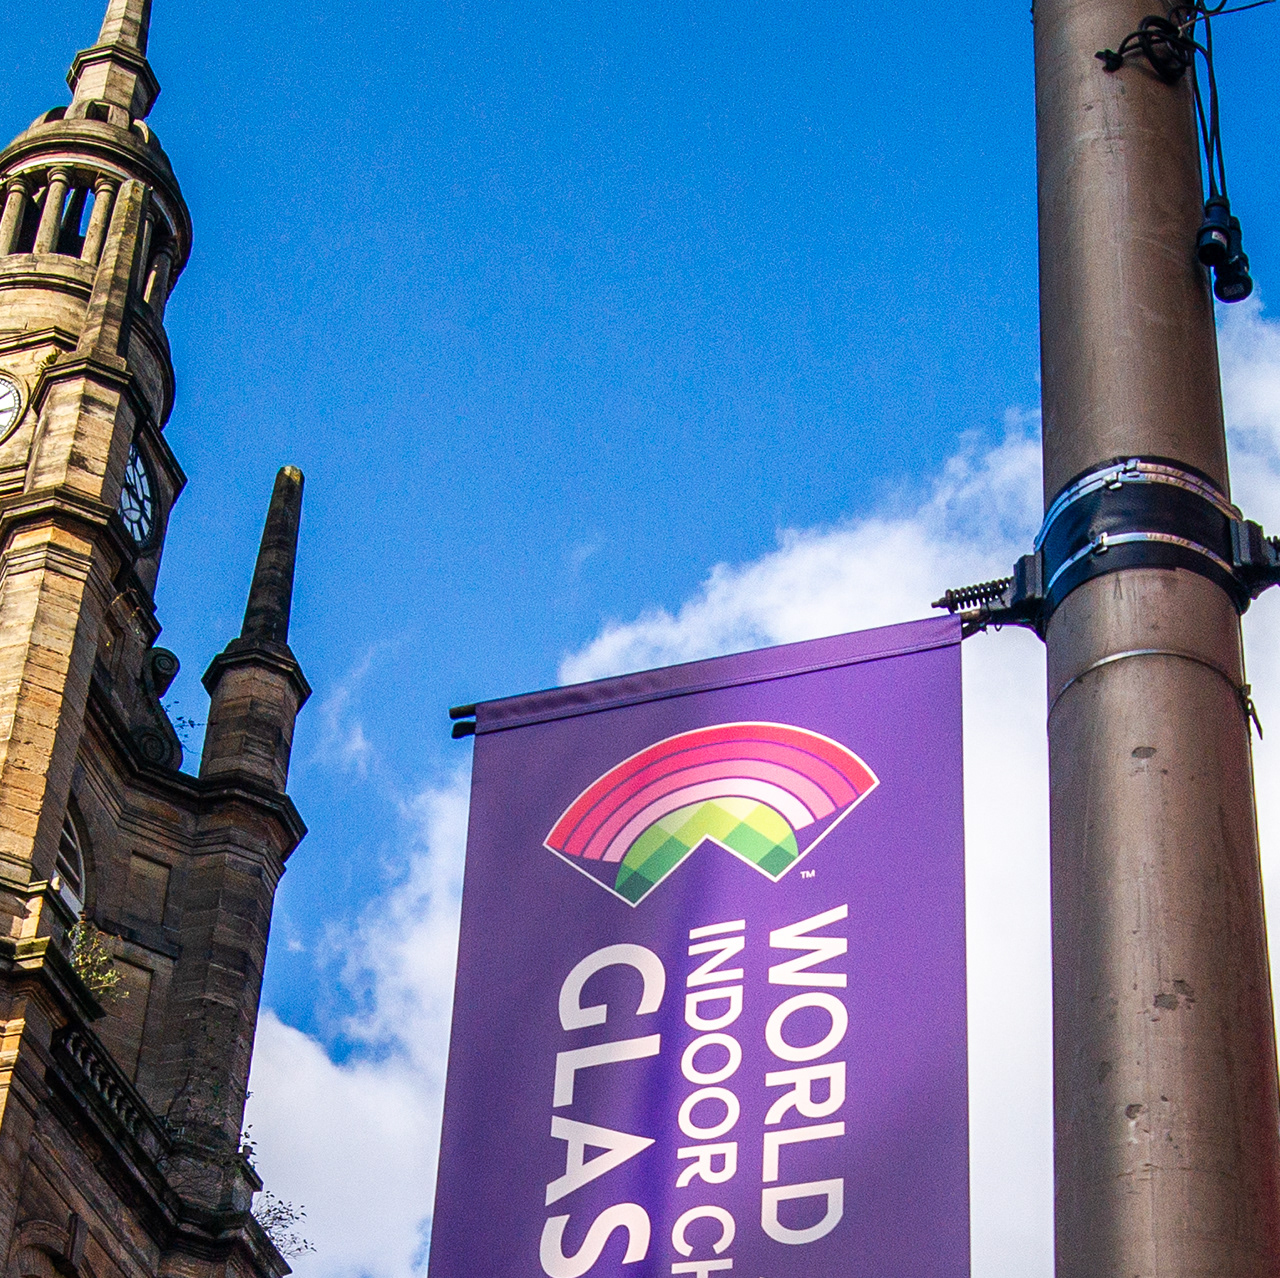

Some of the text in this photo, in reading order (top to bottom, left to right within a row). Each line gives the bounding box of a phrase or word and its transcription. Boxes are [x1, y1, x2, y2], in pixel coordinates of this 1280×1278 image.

[800, 869, 816, 879] TM
[675, 918, 746, 1188] INDOOR
[761, 903, 849, 1246] WORLD
